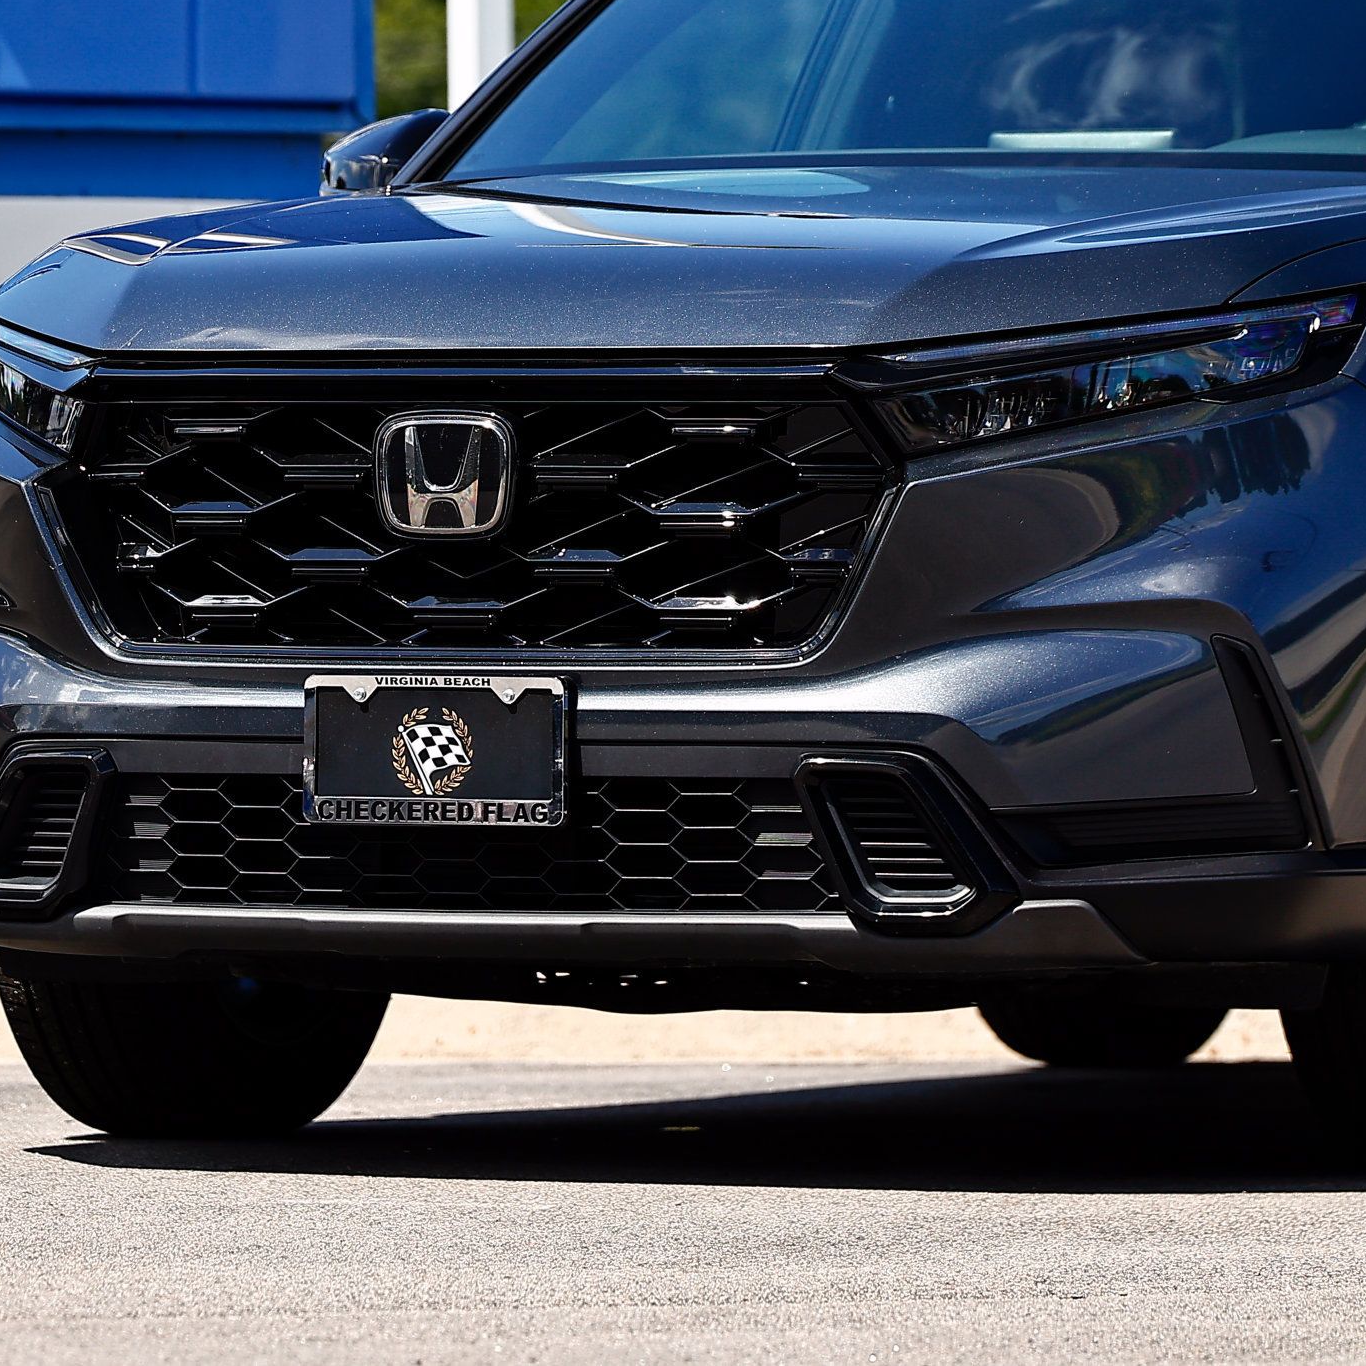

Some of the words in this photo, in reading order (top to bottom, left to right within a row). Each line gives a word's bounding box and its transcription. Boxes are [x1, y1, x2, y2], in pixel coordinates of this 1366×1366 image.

[375, 676, 438, 686] VIRGINIA
[443, 677, 491, 687] BEACH
[318, 799, 475, 822] CHECKERED
[483, 801, 549, 823] FLAG
